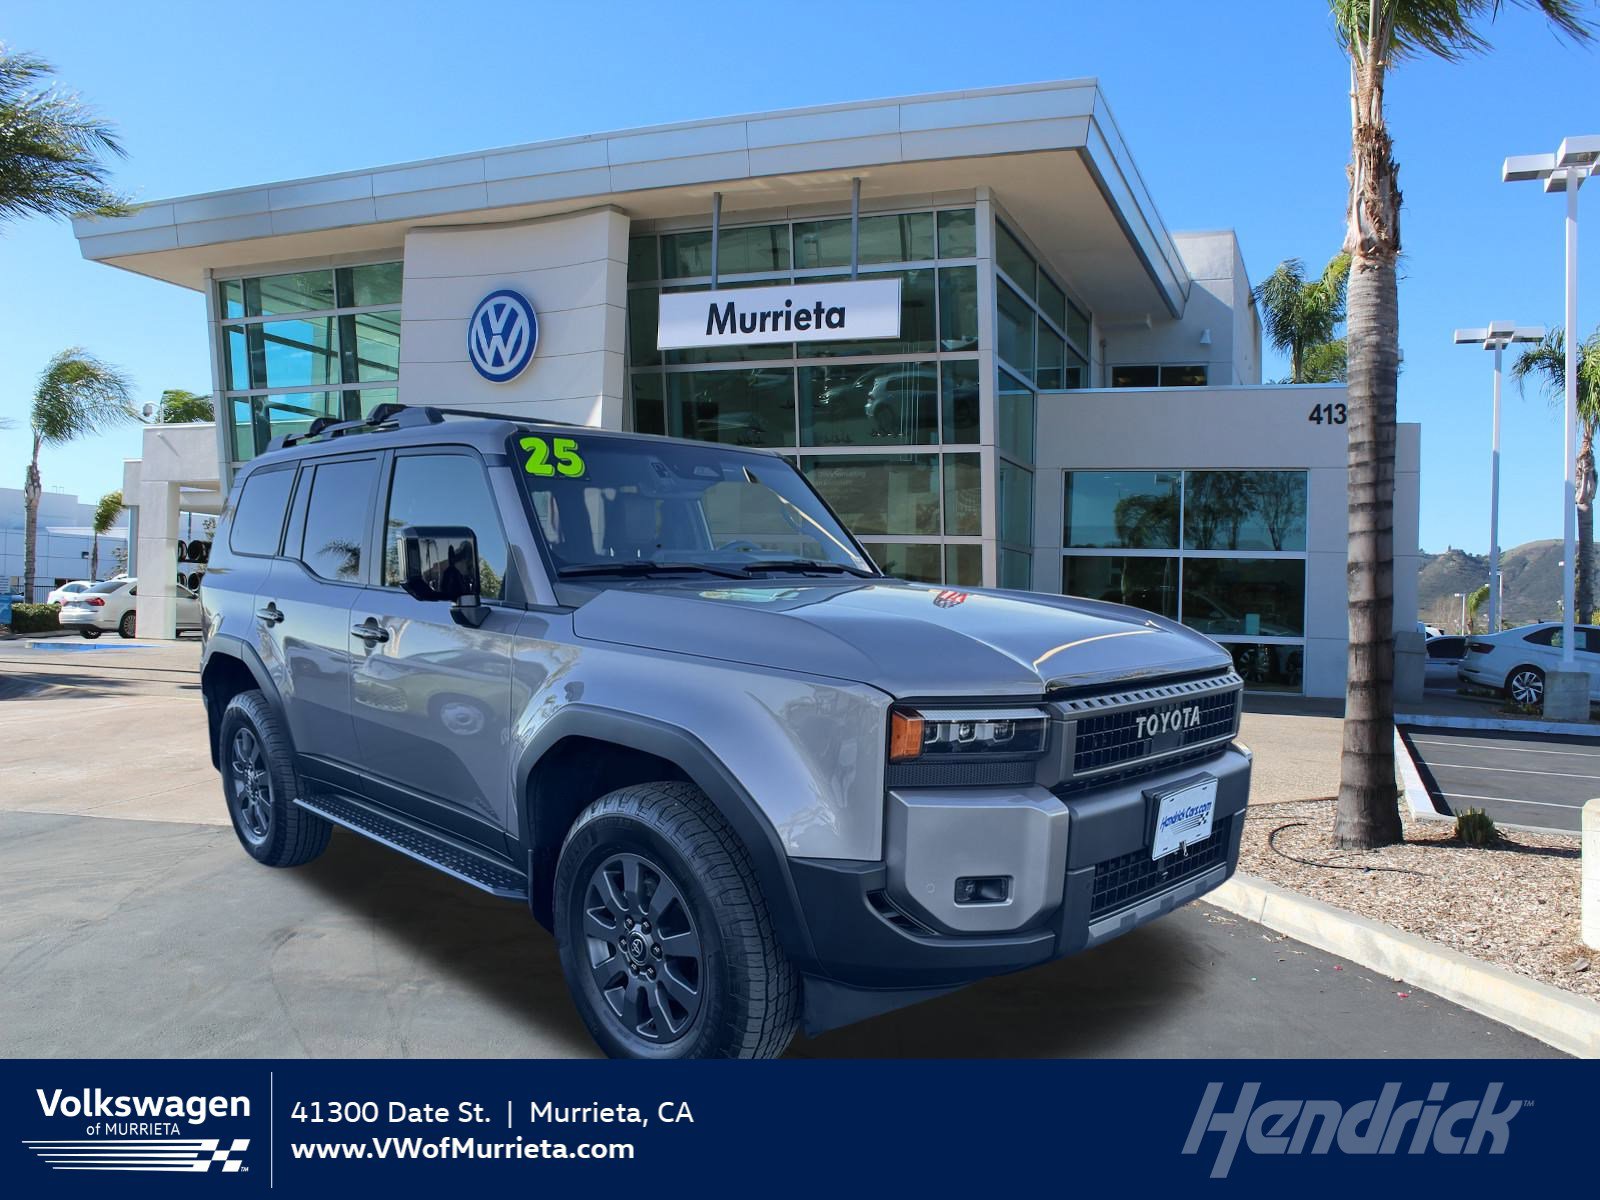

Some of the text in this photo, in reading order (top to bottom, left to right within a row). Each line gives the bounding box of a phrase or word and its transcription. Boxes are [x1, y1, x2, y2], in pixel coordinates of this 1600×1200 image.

[706, 299, 846, 335] Murrieta
[1308, 403, 1347, 425] 413
[519, 436, 585, 477] 25
[1136, 706, 1201, 738] TOYOTA
